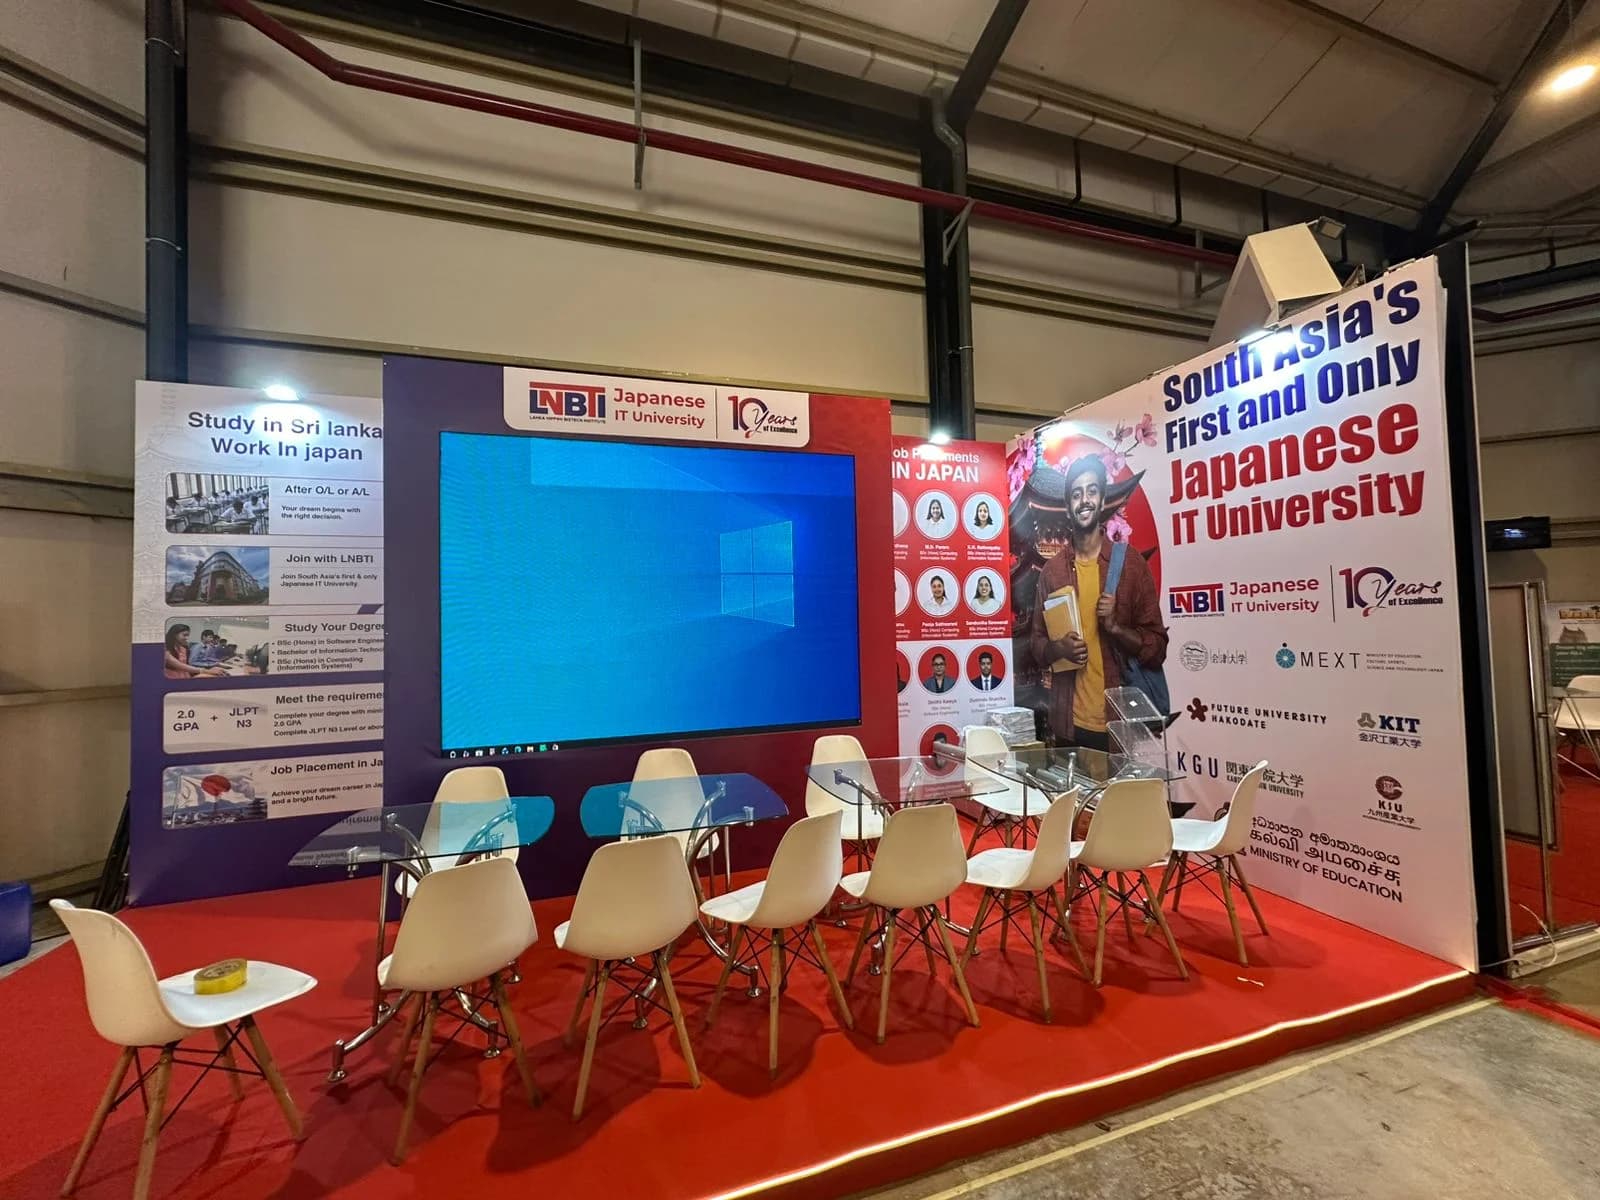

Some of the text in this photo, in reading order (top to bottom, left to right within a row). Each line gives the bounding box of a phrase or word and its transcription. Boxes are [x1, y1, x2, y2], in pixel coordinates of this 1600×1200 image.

[1163, 280, 1420, 413] South Asia's
[529, 382, 606, 418] LNBTI
[614, 388, 706, 408] Japanese
[1165, 338, 1420, 454] First and Only
[188, 412, 383, 438] Study in Sri lanka
[615, 410, 705, 429] IT University
[728, 395, 768, 437] 10
[211, 437, 363, 462] Work In japan
[912, 448, 980, 464] Pments
[1169, 403, 1419, 504] Japanese
[891, 460, 979, 483] IN JAPAN
[285, 485, 312, 494] After
[315, 486, 335, 495] O/L
[352, 488, 370, 496] A/L
[1172, 470, 1425, 546] IT University
[286, 554, 374, 563] Join with LNBTI
[1230, 578, 1319, 598] Japanese
[1338, 566, 1442, 616] 10 Years
[1169, 583, 1224, 613] LNBTI
[1232, 598, 1319, 613] IT University
[285, 623, 318, 633] Study
[321, 623, 346, 631] Your
[1300, 652, 1360, 669] MEXT
[276, 692, 384, 704] Meet the requireme
[177, 710, 195, 719] 2.0
[229, 706, 259, 717] JLPT
[1211, 704, 1327, 725] FUTURE UNIVERSITY
[172, 722, 200, 732] GPA
[236, 719, 252, 728] N3
[1212, 715, 1266, 729] HAKODATE
[1379, 714, 1420, 733] KIT
[1358, 732, 1422, 748] 金沢工業大学
[270, 765, 292, 775] Job
[296, 760, 355, 773] Placement
[1177, 751, 1218, 778] KGU
[1226, 761, 1304, 788] 関東院大学
[1269, 783, 1304, 798] UNIVERSITY
[1368, 808, 1415, 824] 九州産業大学
[1378, 800, 1402, 813] KIU
[1250, 829, 1299, 852] கல்வி
[1250, 845, 1403, 903] MINISTRY OF EDUCATION
